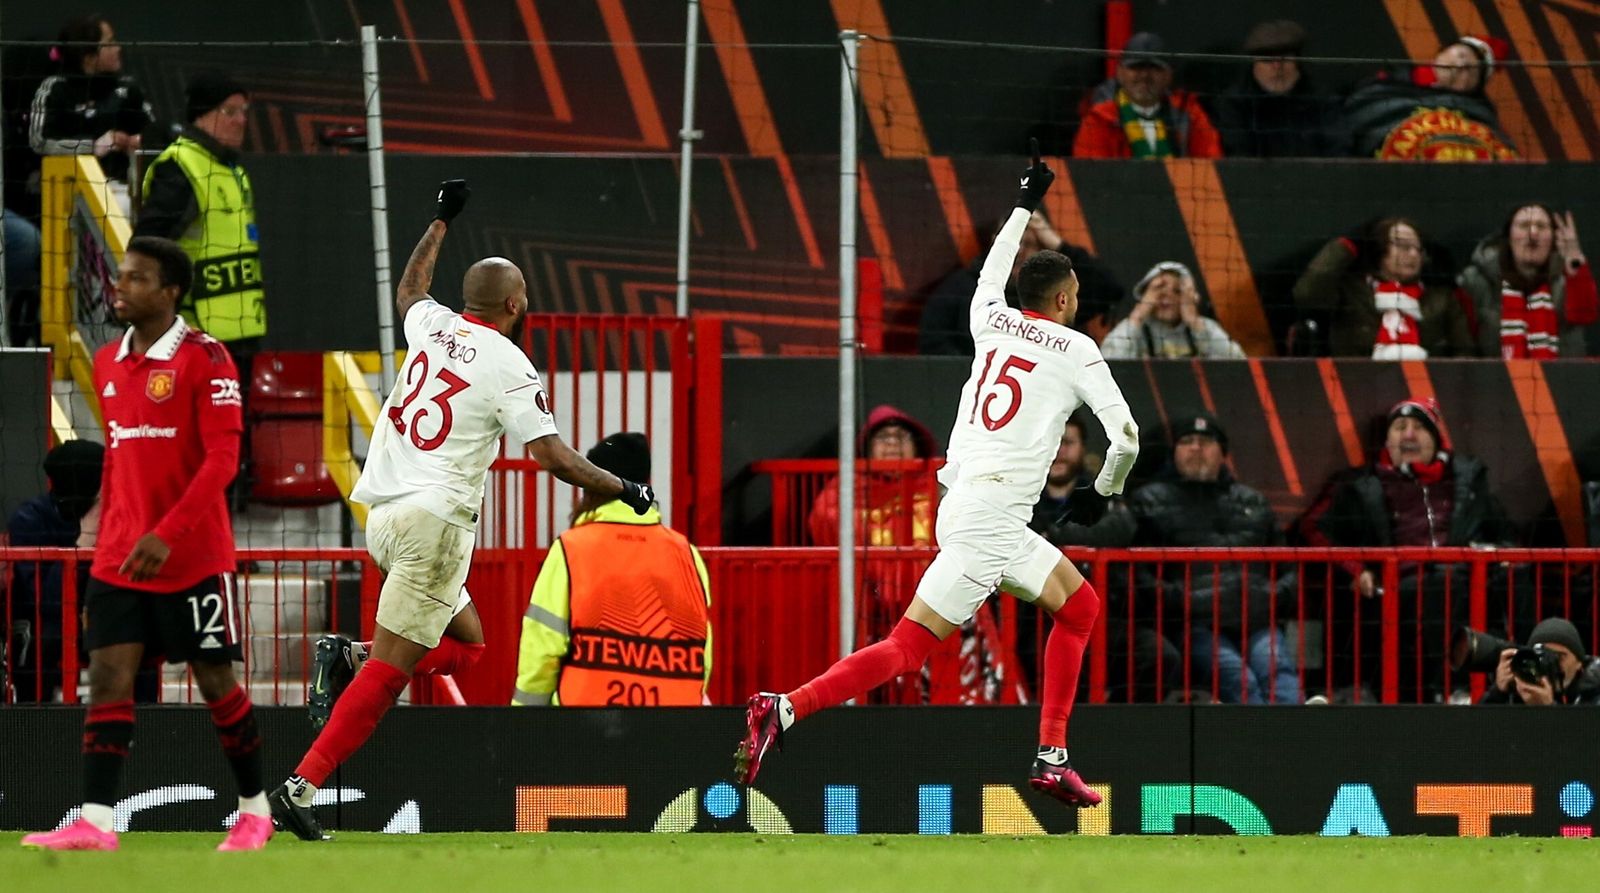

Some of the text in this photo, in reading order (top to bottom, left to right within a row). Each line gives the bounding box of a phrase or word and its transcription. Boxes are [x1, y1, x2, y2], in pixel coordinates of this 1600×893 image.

[987, 309, 1071, 352] Y.EN-NESYRI
[388, 350, 471, 451] 23
[969, 347, 1038, 431] 15
[187, 593, 225, 633] 12
[573, 634, 705, 673] STEWARD
[606, 680, 660, 706] 201
